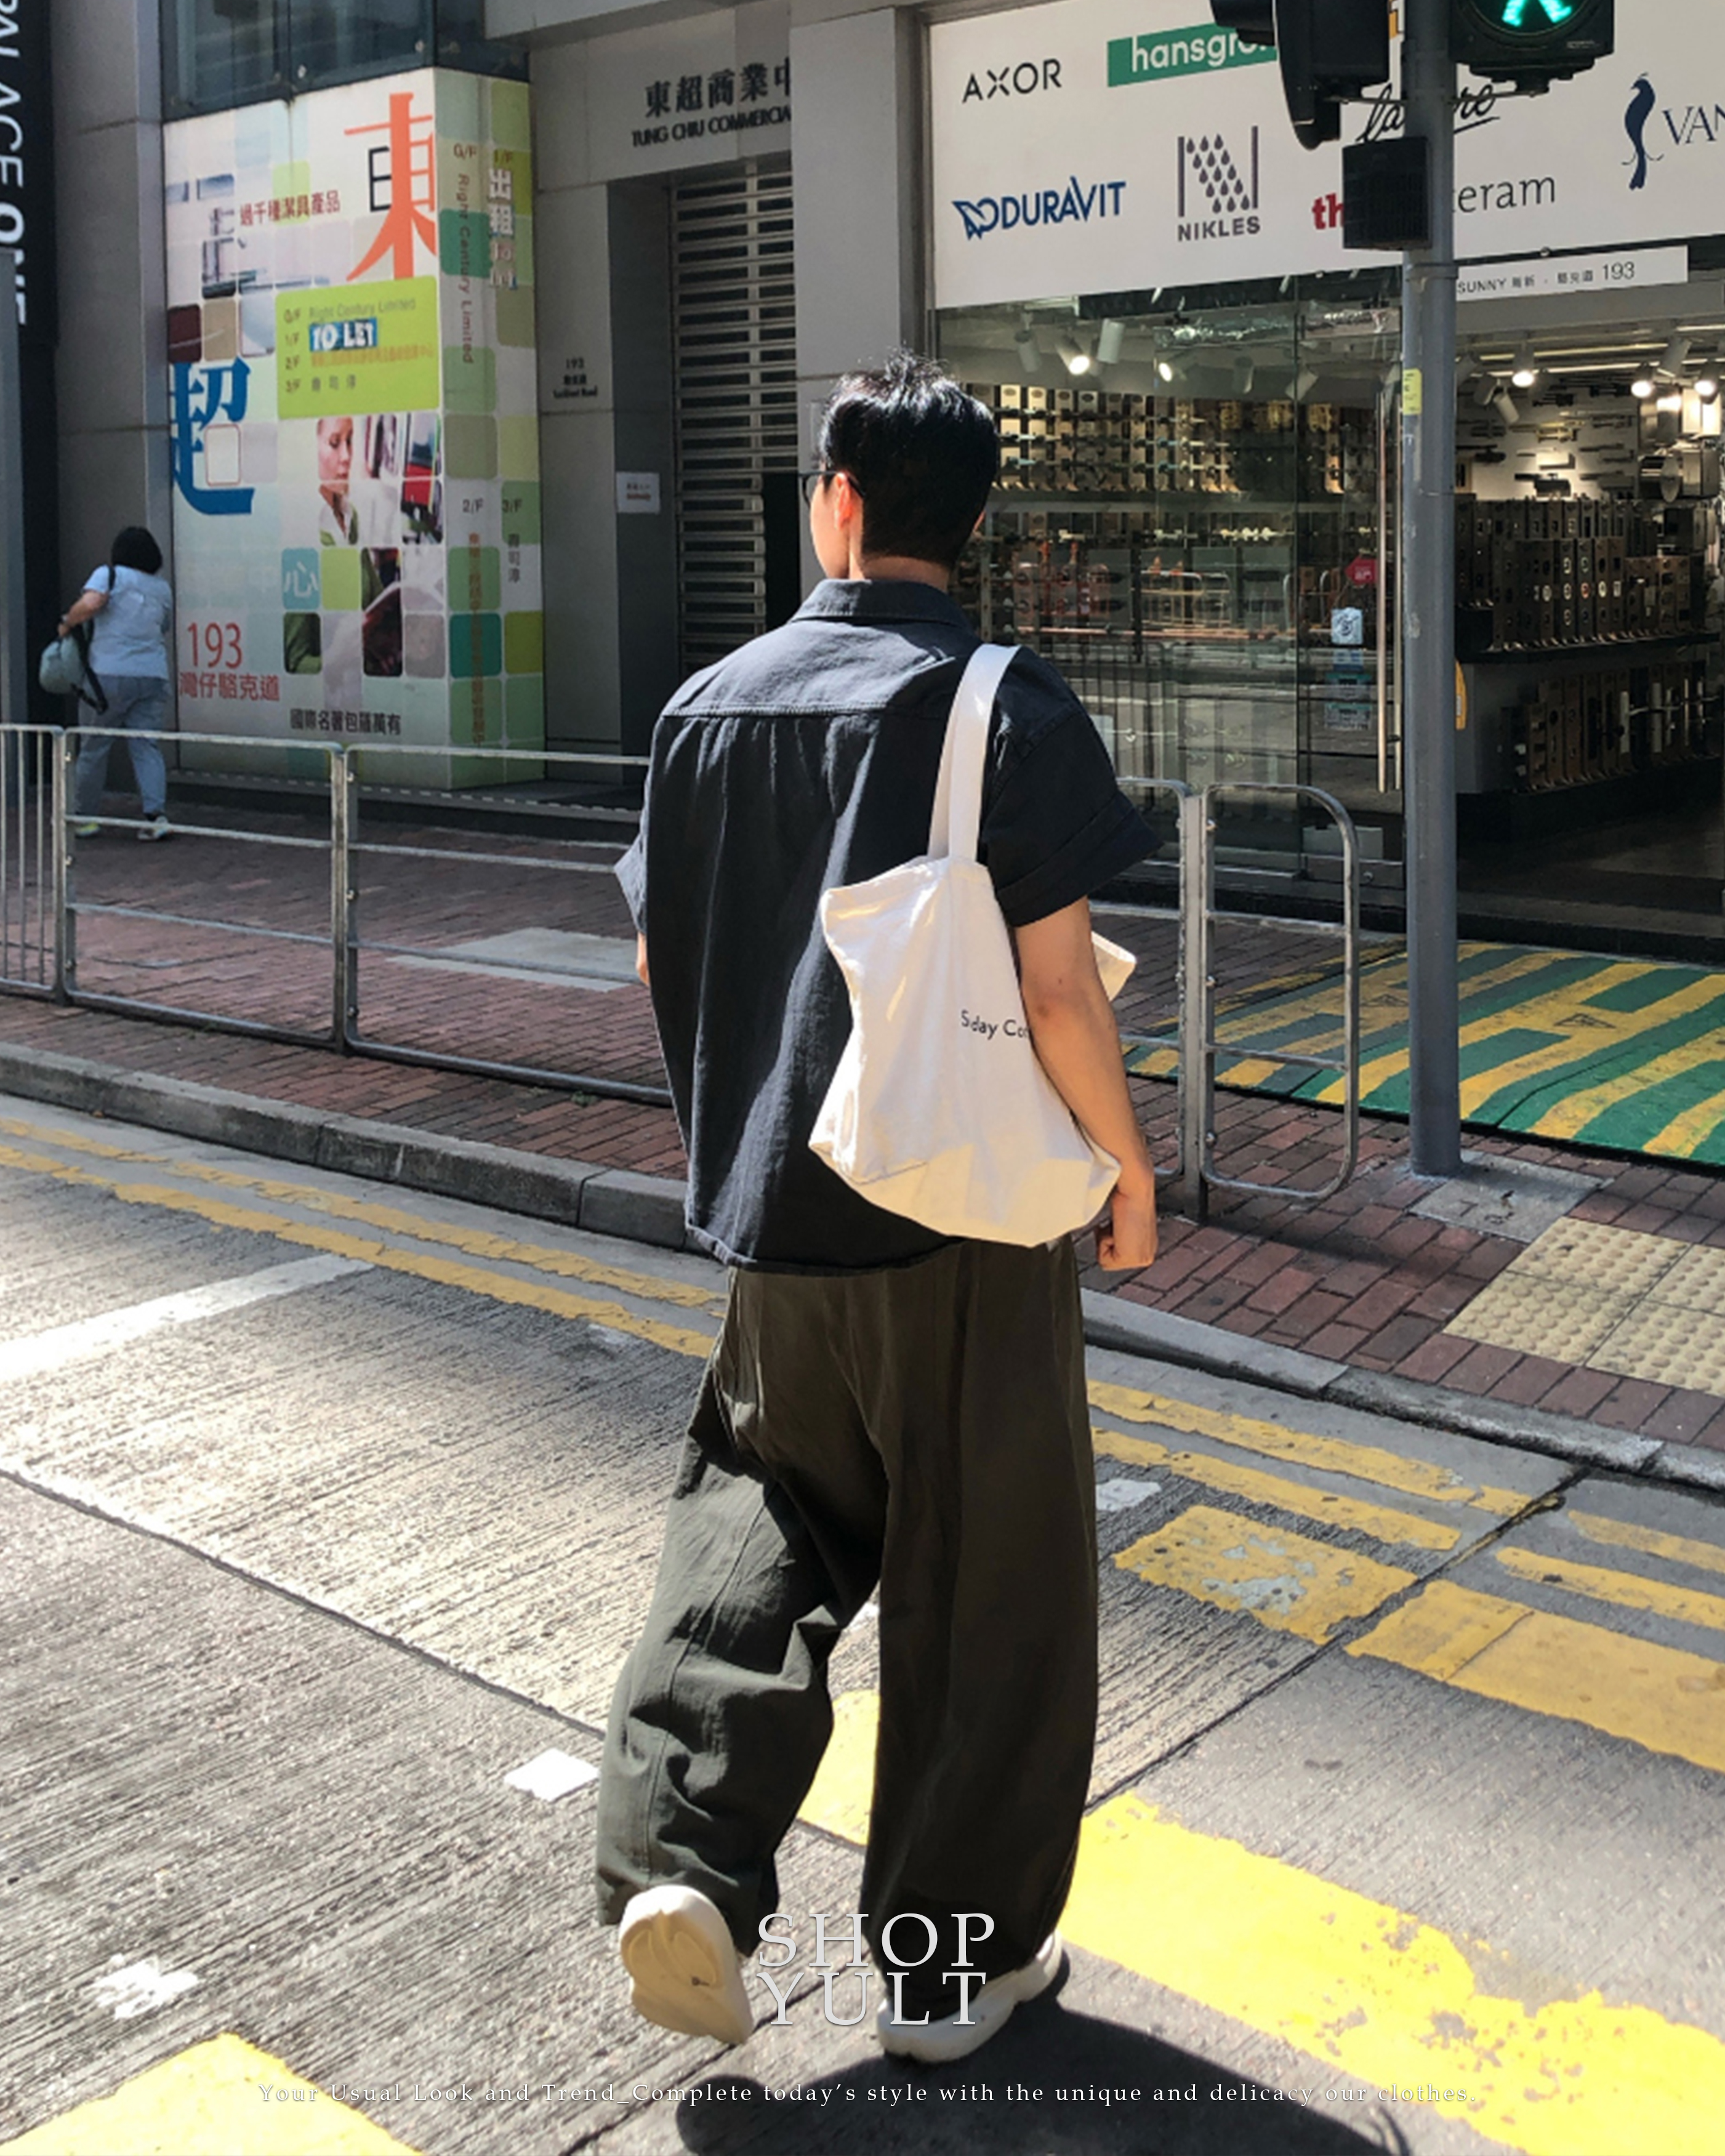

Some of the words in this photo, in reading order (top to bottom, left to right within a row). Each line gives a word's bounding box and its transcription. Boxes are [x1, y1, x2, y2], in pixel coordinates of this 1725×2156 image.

[1131, 33, 1276, 73] hansgr
[645, 56, 790, 118] 東超商業中
[962, 58, 1061, 104] AXOR
[632, 126, 669, 147] TUNG
[672, 120, 704, 141] CHIU
[1002, 177, 1126, 230] DURAVIT
[1177, 216, 1261, 242] NIKLES
[1457, 278, 1507, 294] SUNNY
[1602, 262, 1635, 281] 193
[312, 324, 339, 351] TO
[343, 321, 374, 347] LET
[462, 497, 483, 514] 2/F
[187, 622, 243, 669] 193
